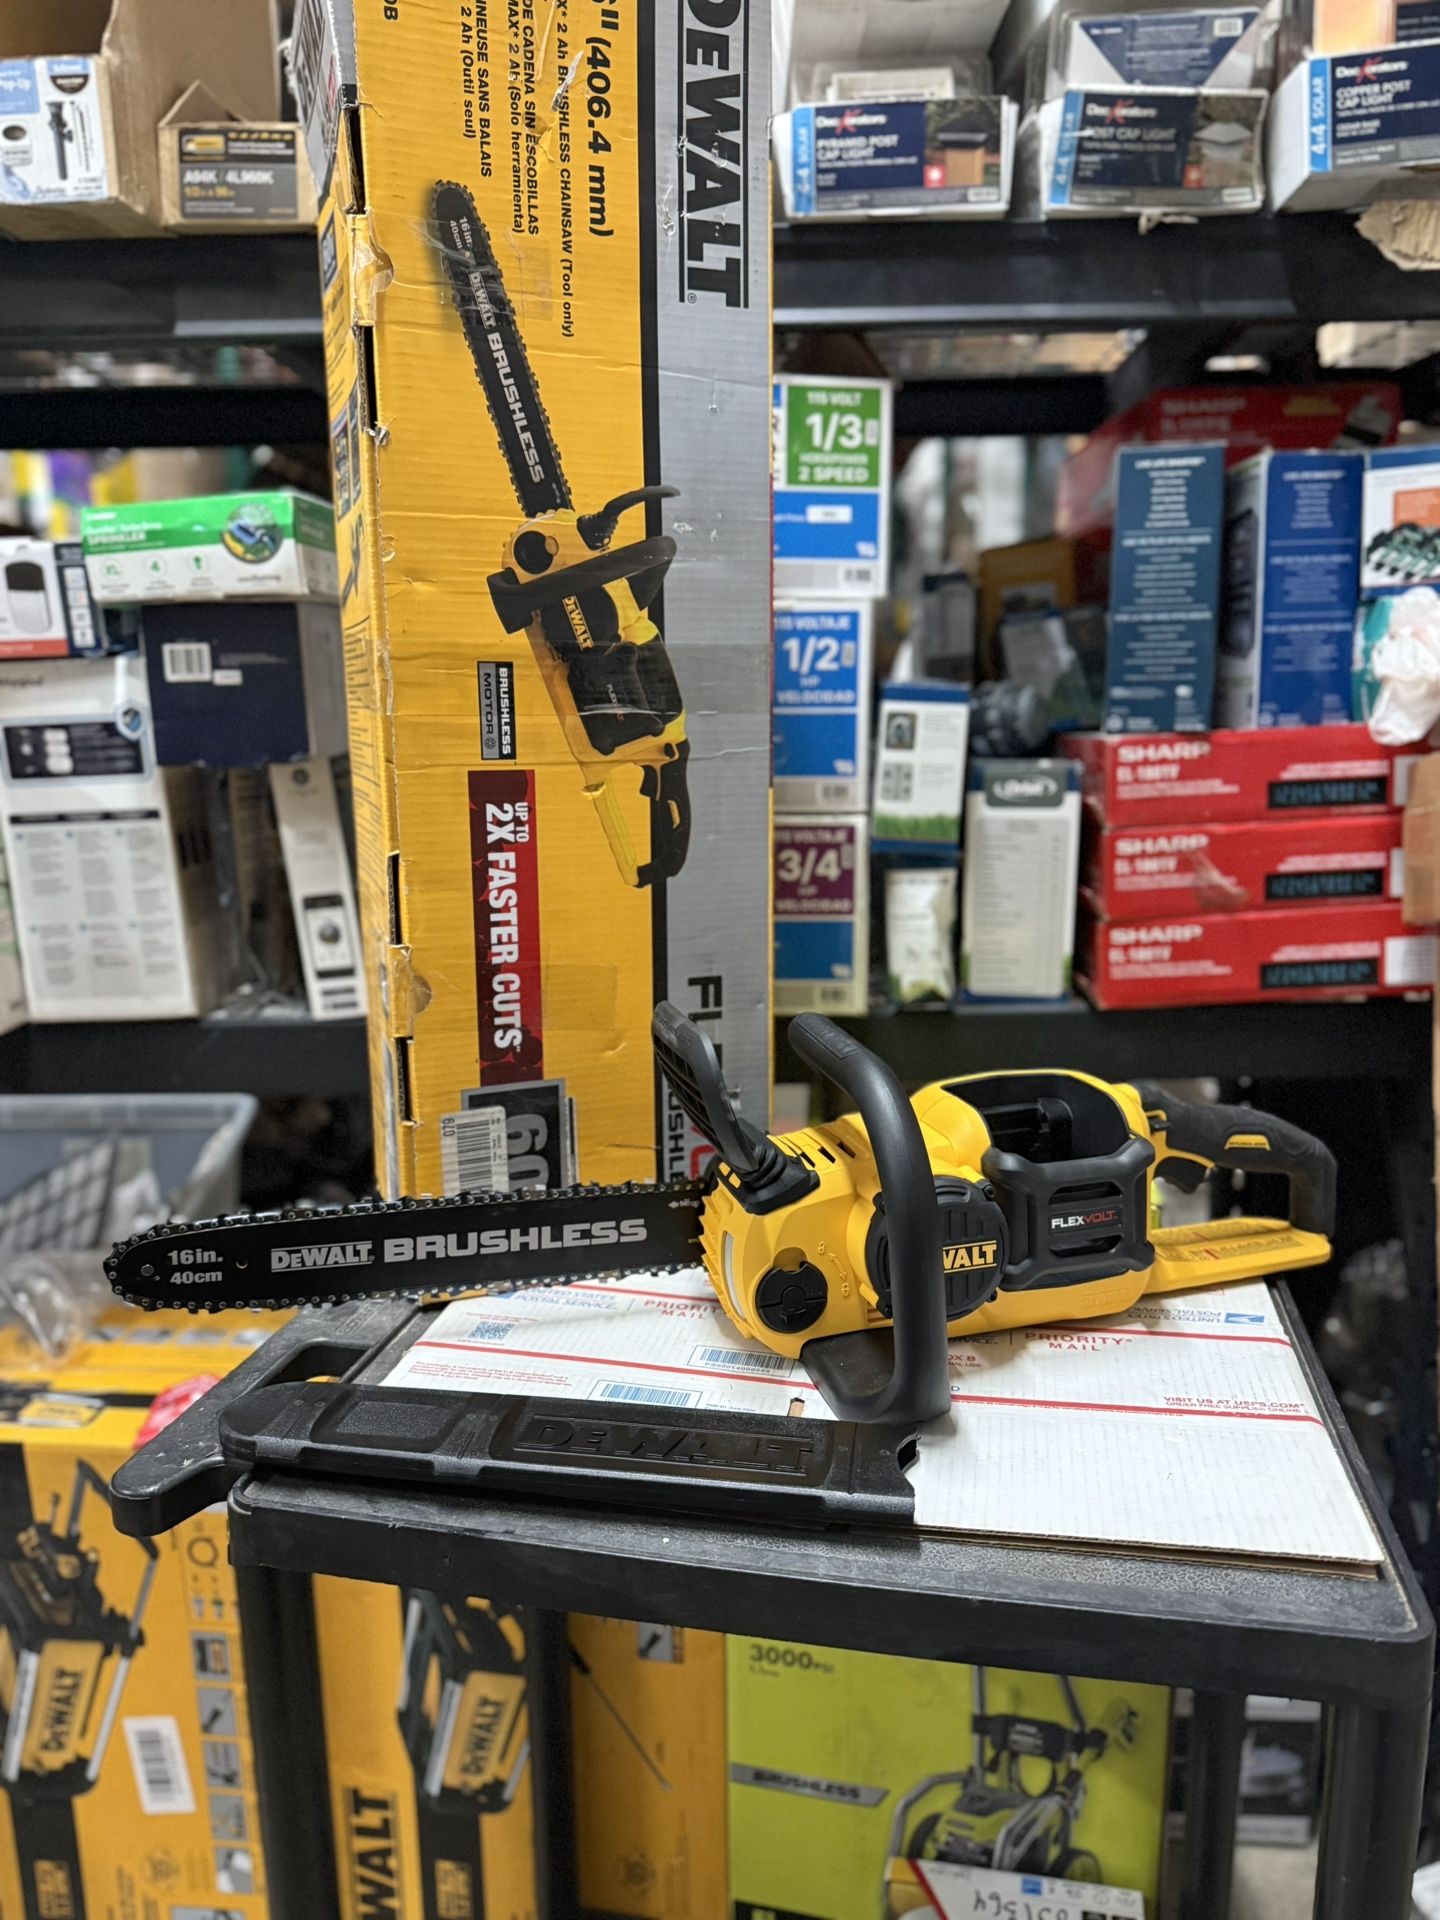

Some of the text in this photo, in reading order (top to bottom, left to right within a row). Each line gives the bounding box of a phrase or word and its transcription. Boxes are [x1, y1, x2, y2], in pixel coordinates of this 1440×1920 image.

[508, 43, 518, 54] 2
[557, 22, 567, 34] 2
[523, 28, 535, 95] CADENA
[557, 38, 569, 60] Ah
[460, 6, 477, 140] 2 Ah (Outil seul)
[478, 67, 490, 113] SANS
[507, 85, 522, 127] (Solo
[525, 100, 537, 129] SIN
[586, 36, 613, 155] (406.4
[1311, 76, 1325, 119] SOLAR
[480, 117, 492, 178] BALAIS
[510, 131, 525, 235] herramienta)
[525, 133, 539, 236] ESCOBILLAS
[588, 164, 614, 238] mm)
[560, 168, 573, 254] CHAINSAW
[561, 258, 573, 297] (Tool
[561, 301, 575, 338] only)
[469, 272, 545, 484] DEWALT BRUSHLESS
[805, 412, 864, 452] 1/3
[562, 594, 594, 651] DEWALT
[782, 635, 841, 676] 1/2
[483, 672, 494, 735] MOTOR
[498, 667, 513, 755] BRUSHLESS
[1117, 740, 1212, 764] SHARP
[515, 801, 530, 843] UP TO
[1114, 833, 1209, 857] SHARP
[777, 847, 842, 885] 3/4
[485, 802, 523, 1050] 2X FASTER CUTS
[1108, 924, 1204, 946] SHARP
[1051, 1209, 1117, 1230] FLEXVOLT
[167, 1248, 224, 1267] 16in.
[271, 1218, 648, 1271] DEWALT BRUSHLESS
[170, 1270, 223, 1286] 40cm
[643, 1299, 718, 1314] PRIORIT
[660, 1309, 706, 1320] MAIL
[1024, 1332, 1127, 1347] PRIORITY
[1048, 1341, 1101, 1352] MAIL
[521, 1417, 813, 1471] DEWALT
[460, 1695, 502, 1778] DEWALT
[753, 1769, 860, 1800] BRUSHLESS
